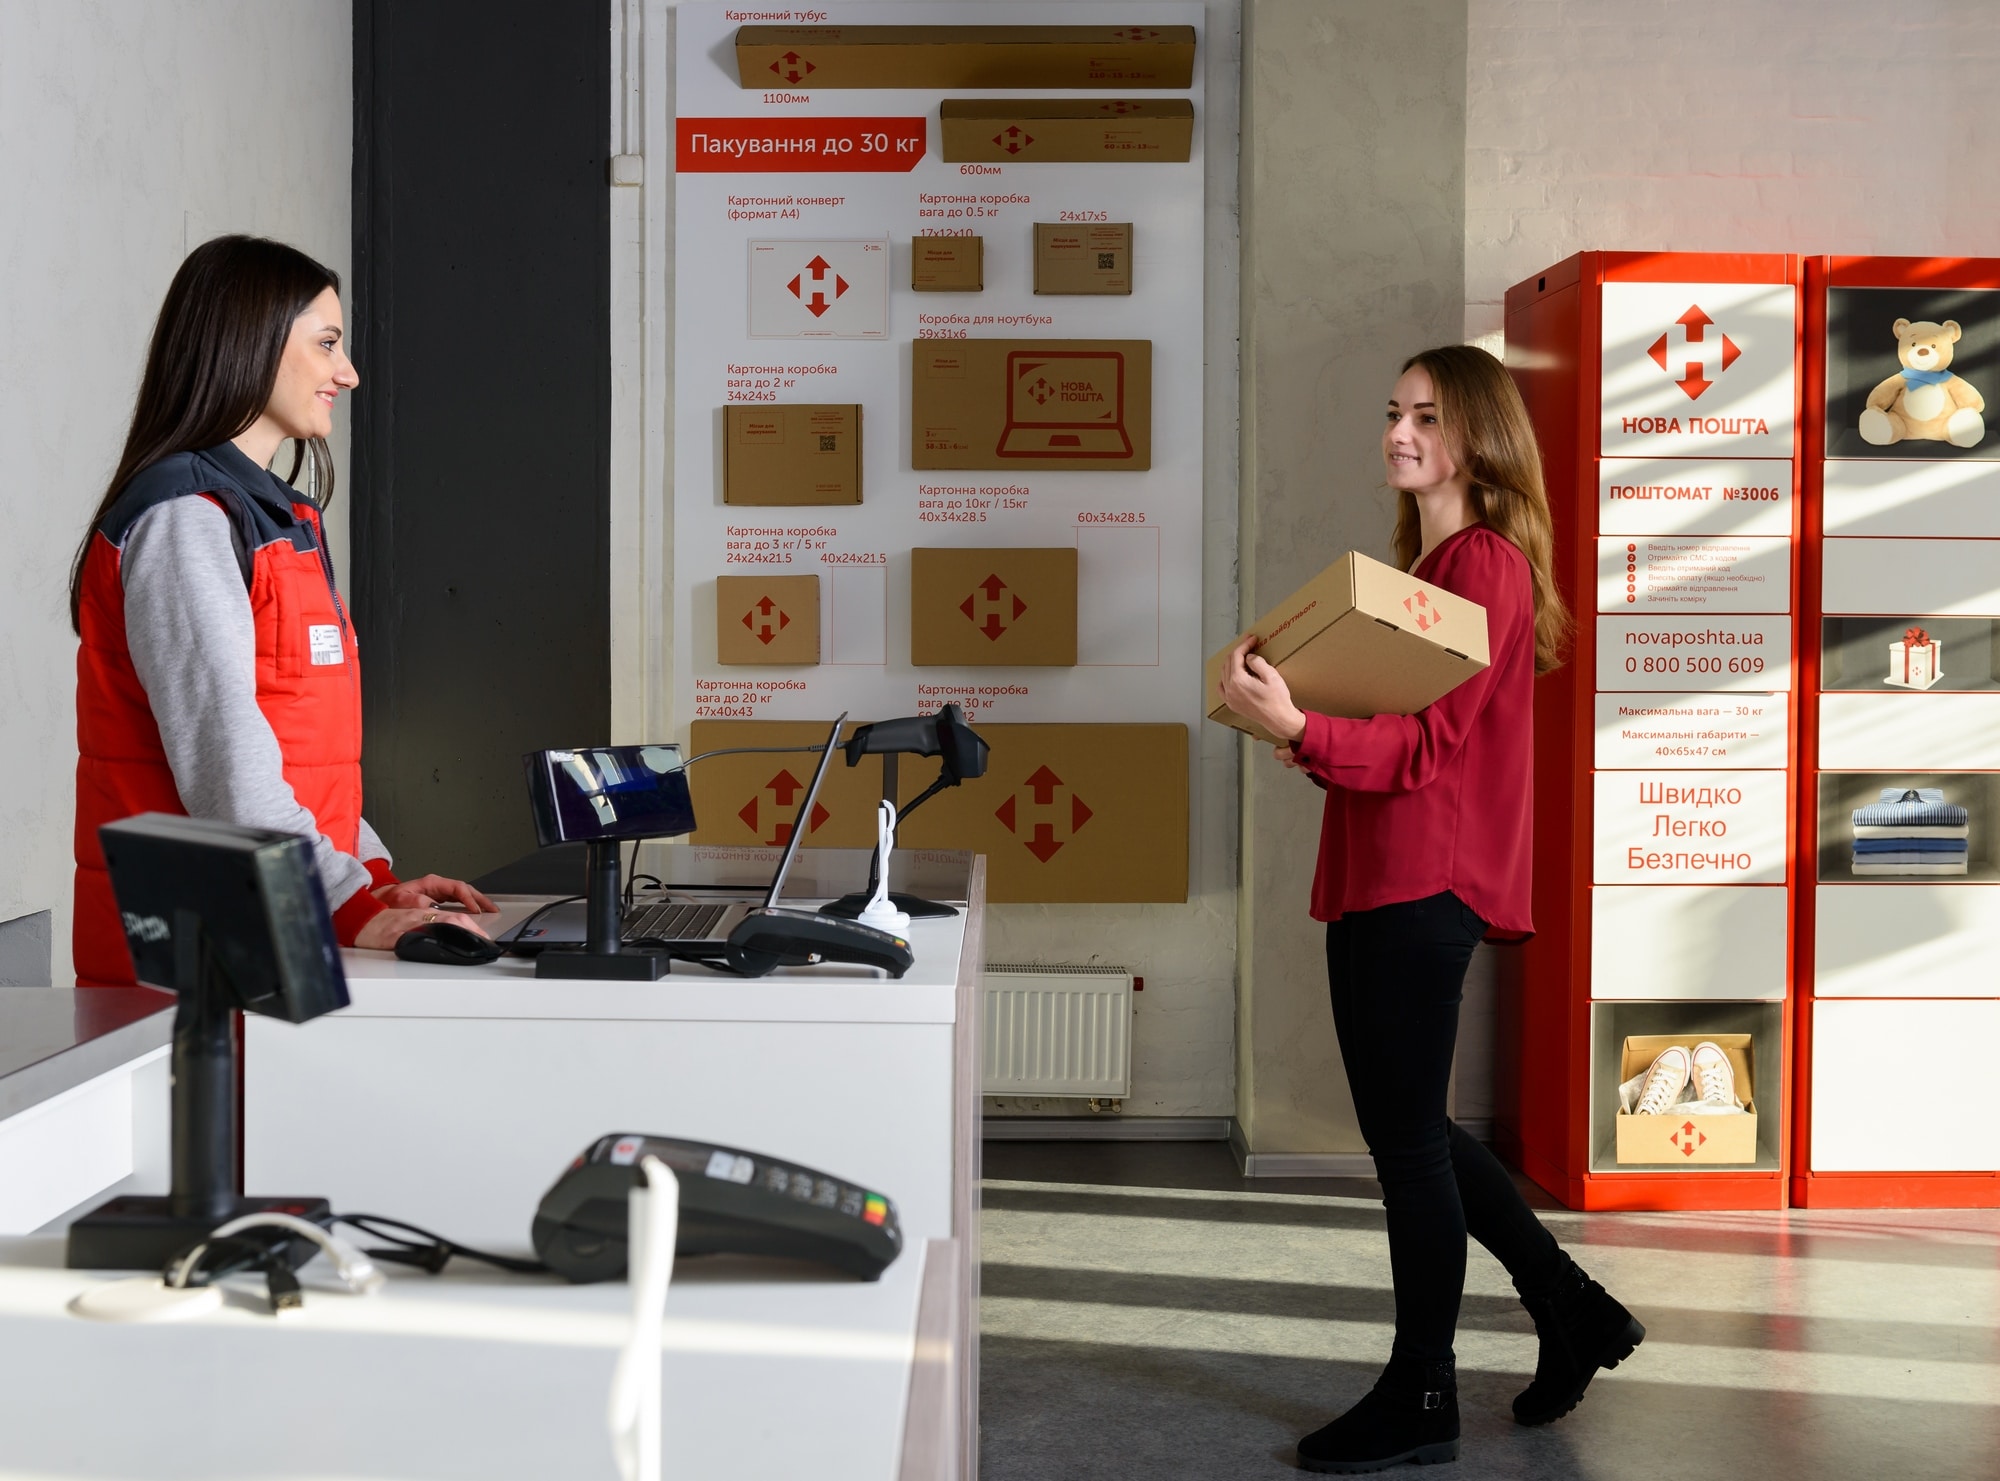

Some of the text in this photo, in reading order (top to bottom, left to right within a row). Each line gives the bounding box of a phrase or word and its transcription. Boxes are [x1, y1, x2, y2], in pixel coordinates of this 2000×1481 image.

[726, 10, 827, 22] Картонний тубус
[764, 94, 810, 104] 1100мм
[691, 133, 919, 158] Пакування до 30 кг
[960, 165, 1001, 174] 600мм
[728, 195, 845, 207] Картонний конверт
[920, 194, 1030, 205] Картонна коробка
[728, 210, 777, 221] (формат
[919, 207, 999, 218] вага до 0.5 кг
[920, 314, 1053, 326] Коробка для ноутбука
[728, 365, 838, 376] Картонна коробка
[728, 380, 752, 388] вага
[755, 380, 770, 389] до
[774, 378, 780, 388] 2
[1060, 382, 1093, 391] НОВА
[1060, 393, 1104, 402] ПОШТА
[1623, 418, 1768, 434] НОВА ПОШТА
[920, 486, 1030, 496] Картонна коробка
[1610, 486, 1779, 501] ПОШТОМАТ №3006
[947, 501, 962, 510] до
[966, 499, 990, 508] 10кг
[1003, 499, 1028, 509] 15кг
[727, 527, 837, 538] Картонна коробка
[727, 542, 752, 550] вага
[754, 542, 770, 551] до
[774, 539, 779, 549] 3
[806, 540, 812, 550] 5
[1269, 600, 1317, 641] майбутнього
[1626, 630, 1763, 648] novaposhta.ua
[1625, 657, 1764, 673] 0 800 500 609
[696, 680, 806, 691] Картонна коробка
[919, 685, 1028, 696] Картонна коробка
[724, 696, 739, 704] до
[743, 693, 757, 703] 20
[966, 698, 979, 708] 30
[1618, 706, 1693, 716] Максимальна
[1736, 707, 1749, 716] 30
[1622, 730, 1694, 739] Максимальні
[1697, 730, 1747, 740] габарити
[1640, 783, 1742, 808] Швидко
[1653, 815, 1726, 837] Легко
[1628, 848, 1751, 870] Безпечно
